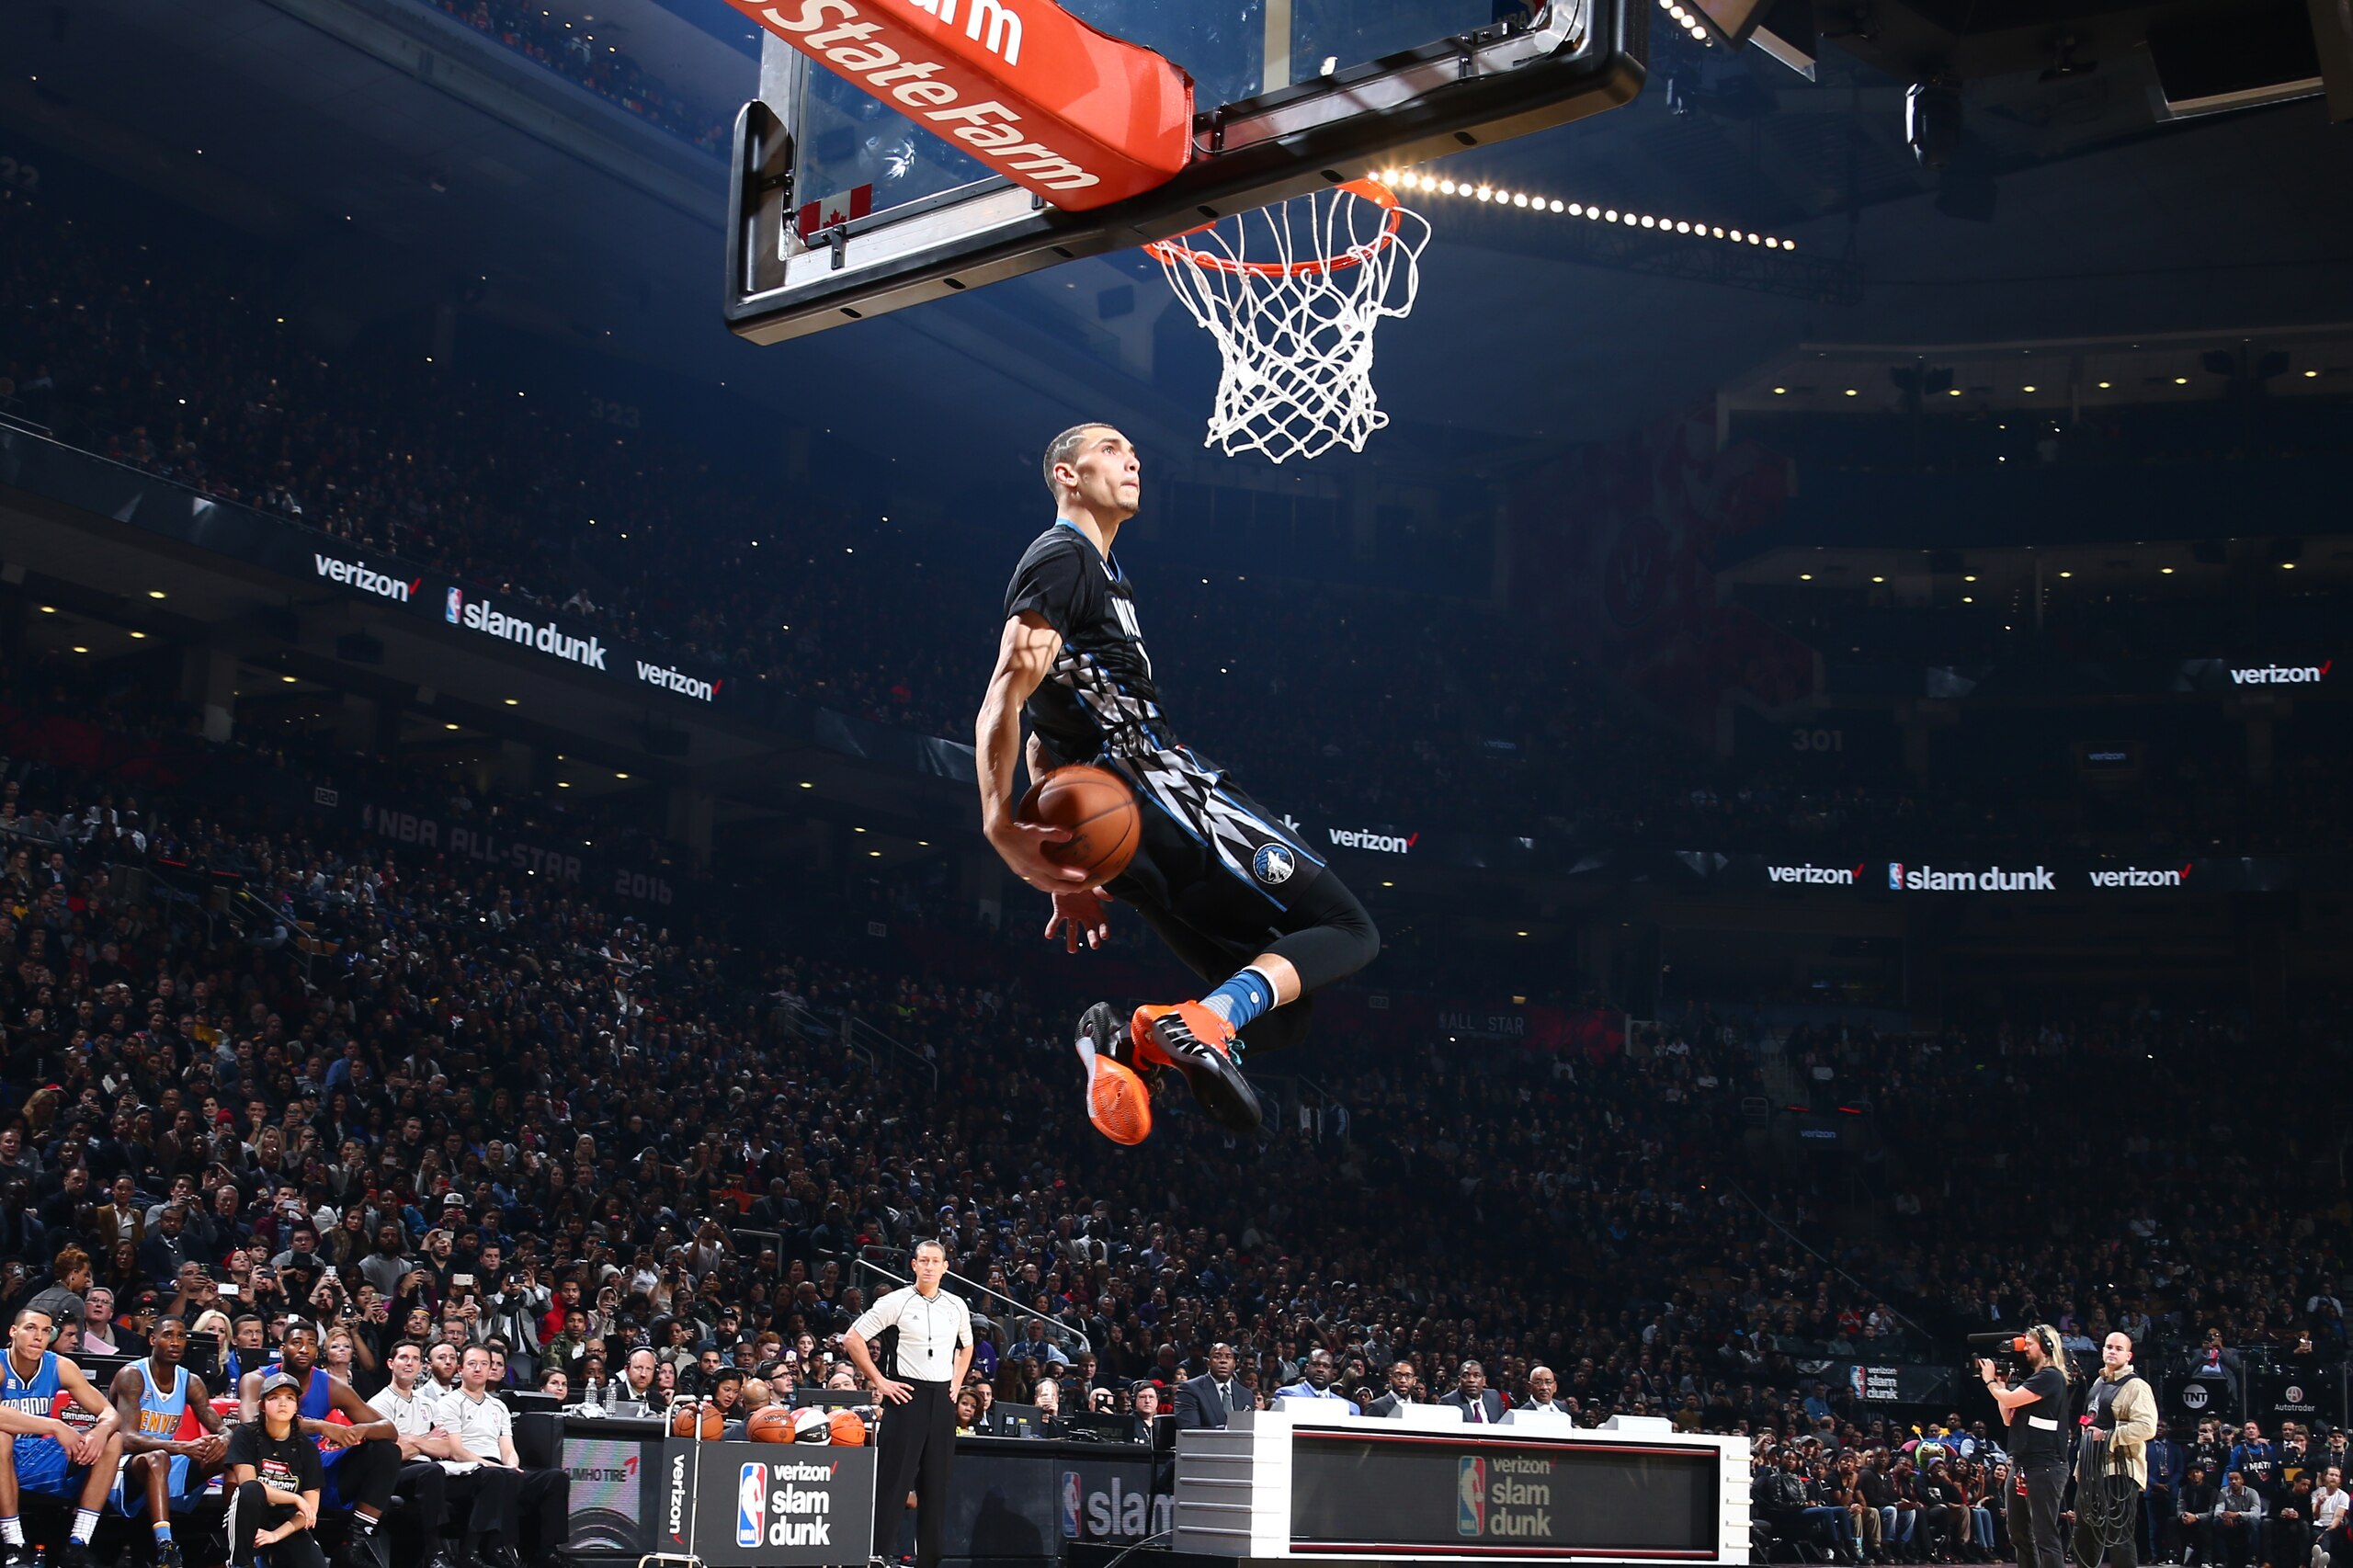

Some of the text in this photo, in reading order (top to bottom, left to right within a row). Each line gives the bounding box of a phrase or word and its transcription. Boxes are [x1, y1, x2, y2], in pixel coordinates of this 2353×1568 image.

[314, 553, 408, 602] verizon
[462, 599, 606, 671] slam dunk
[636, 659, 713, 701] verizon
[2230, 664, 2321, 684] verizon
[1791, 729, 1843, 752] 301
[315, 789, 337, 806] 120
[1328, 828, 1408, 853] verizon
[378, 808, 673, 905] NBA ALL-STAR 2016
[1768, 863, 1853, 884] verizon
[1905, 865, 2055, 891] slam dunk
[2089, 866, 2181, 887] verizon
[1447, 1012, 1525, 1036] ALL STAR
[1867, 1375, 1898, 1387] slam
[1867, 1387, 1898, 1399] dunk
[2183, 1392, 2208, 1403] TNT
[2274, 1403, 2316, 1413] Autotrader
[140, 1410, 181, 1434] ENVE
[566, 1468, 627, 1482] UMHO TIRE
[773, 1461, 831, 1482] verizon
[1492, 1456, 1551, 1474] verizon
[668, 1454, 686, 1534] verizon
[771, 1483, 829, 1514] slam
[1491, 1476, 1551, 1506] slam
[768, 1516, 830, 1546] dunk
[1490, 1507, 1552, 1536] dunk
[740, 1529, 756, 1541] NBA
